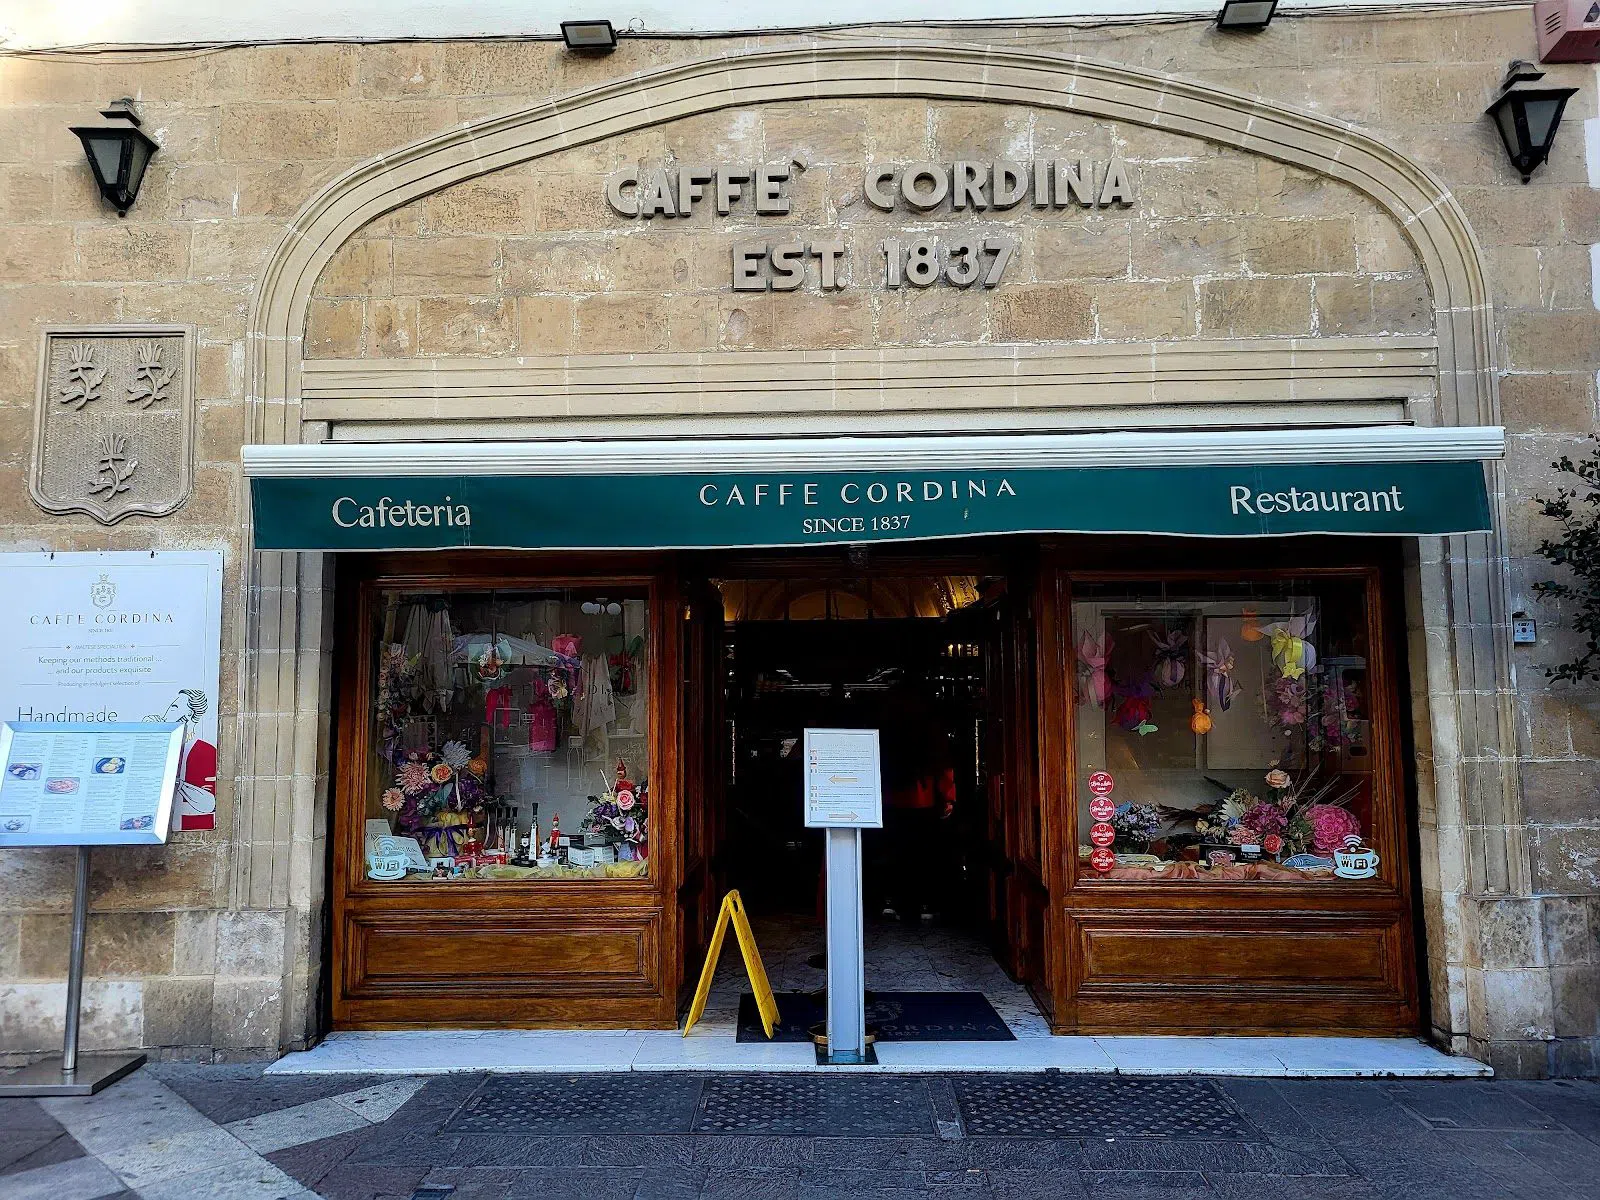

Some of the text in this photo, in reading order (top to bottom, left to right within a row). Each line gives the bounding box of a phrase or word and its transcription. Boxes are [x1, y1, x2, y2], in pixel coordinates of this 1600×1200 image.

[864, 157, 1134, 212] CORDINA
[733, 238, 1014, 292] EST. 1837
[699, 479, 1016, 506] CAFFE CORDINA
[1230, 485, 1404, 515] Restaurant
[332, 496, 471, 528] Cafeteria
[802, 515, 910, 534] SINCE 1837
[30, 613, 174, 625] CAFFE CORDINA
[38, 656, 67, 666] Keeping
[84, 655, 116, 664] methods
[117, 655, 154, 663] traditional
[56, 666, 69, 675] and
[86, 666, 118, 676] products
[119, 666, 152, 676] exquisite
[18, 705, 118, 722] Handmade
